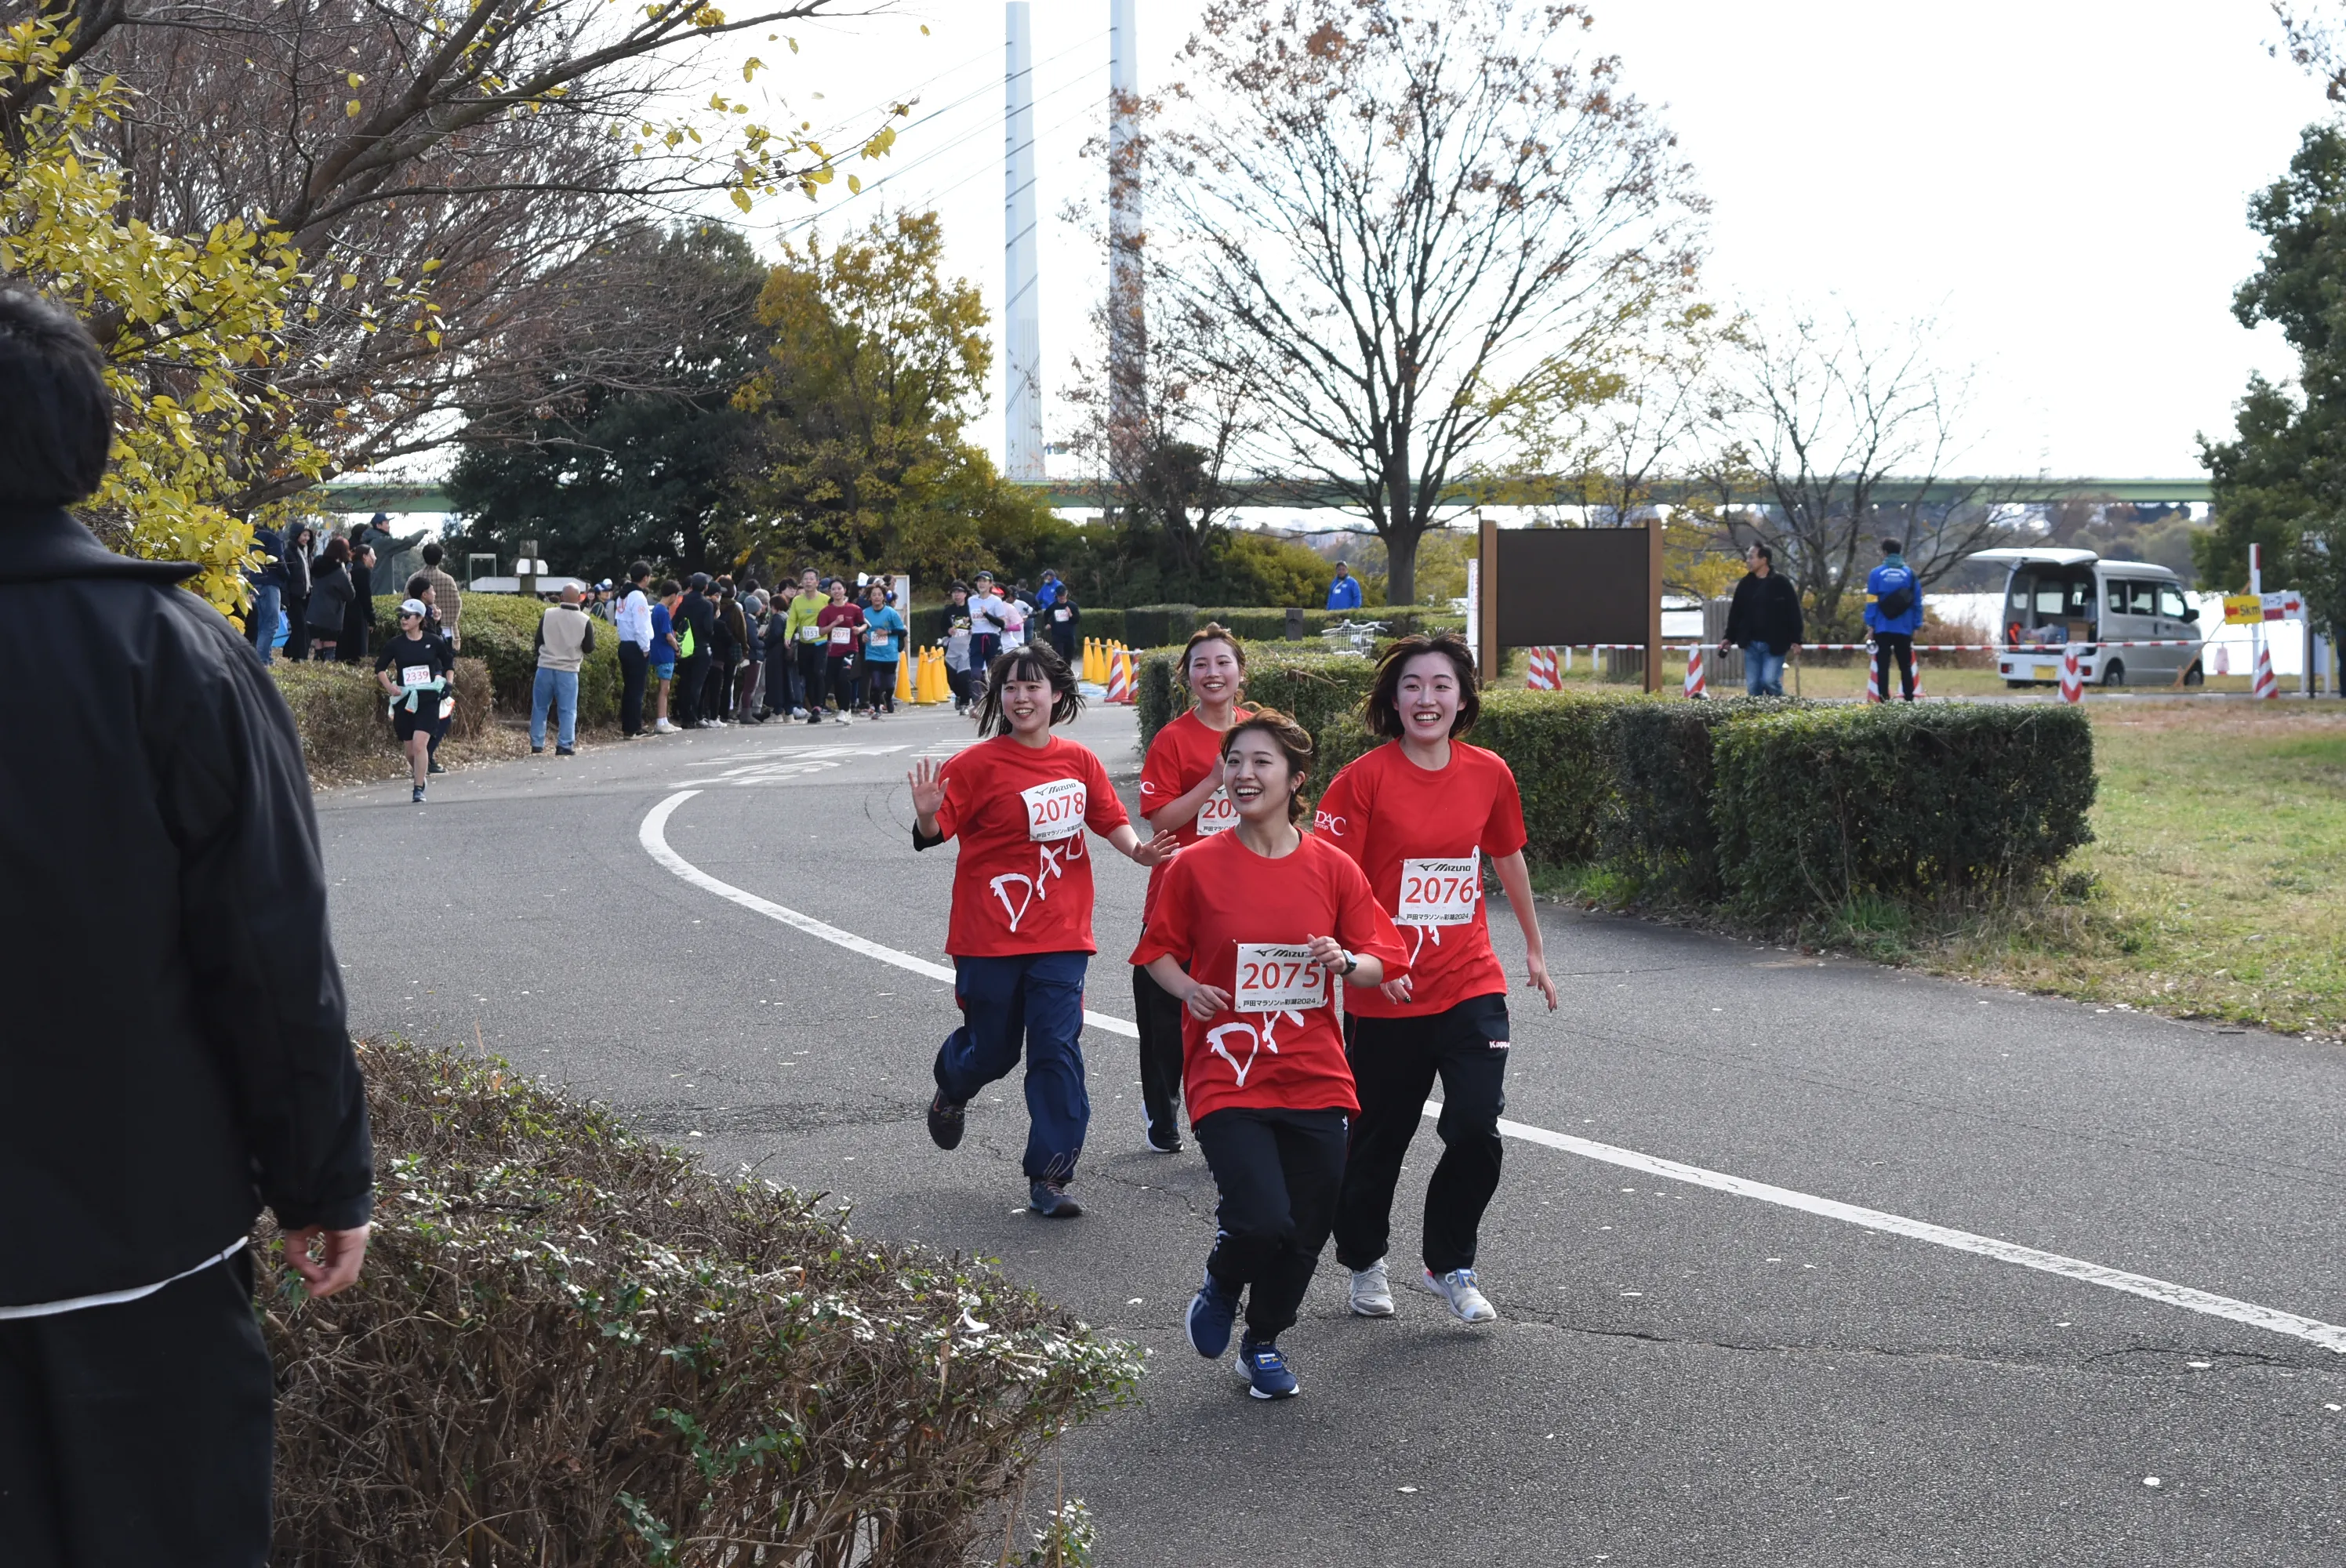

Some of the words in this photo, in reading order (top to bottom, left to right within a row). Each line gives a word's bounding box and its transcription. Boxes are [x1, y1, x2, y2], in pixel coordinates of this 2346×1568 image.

[2239, 603, 2261, 616] 5km
[405, 670, 429, 682] 2339
[1032, 791, 1084, 826] 2078
[1202, 798, 1239, 818] 20
[1314, 810, 1346, 837] DAC
[1404, 877, 1474, 905] 2076
[1241, 962, 1320, 990] 2075
